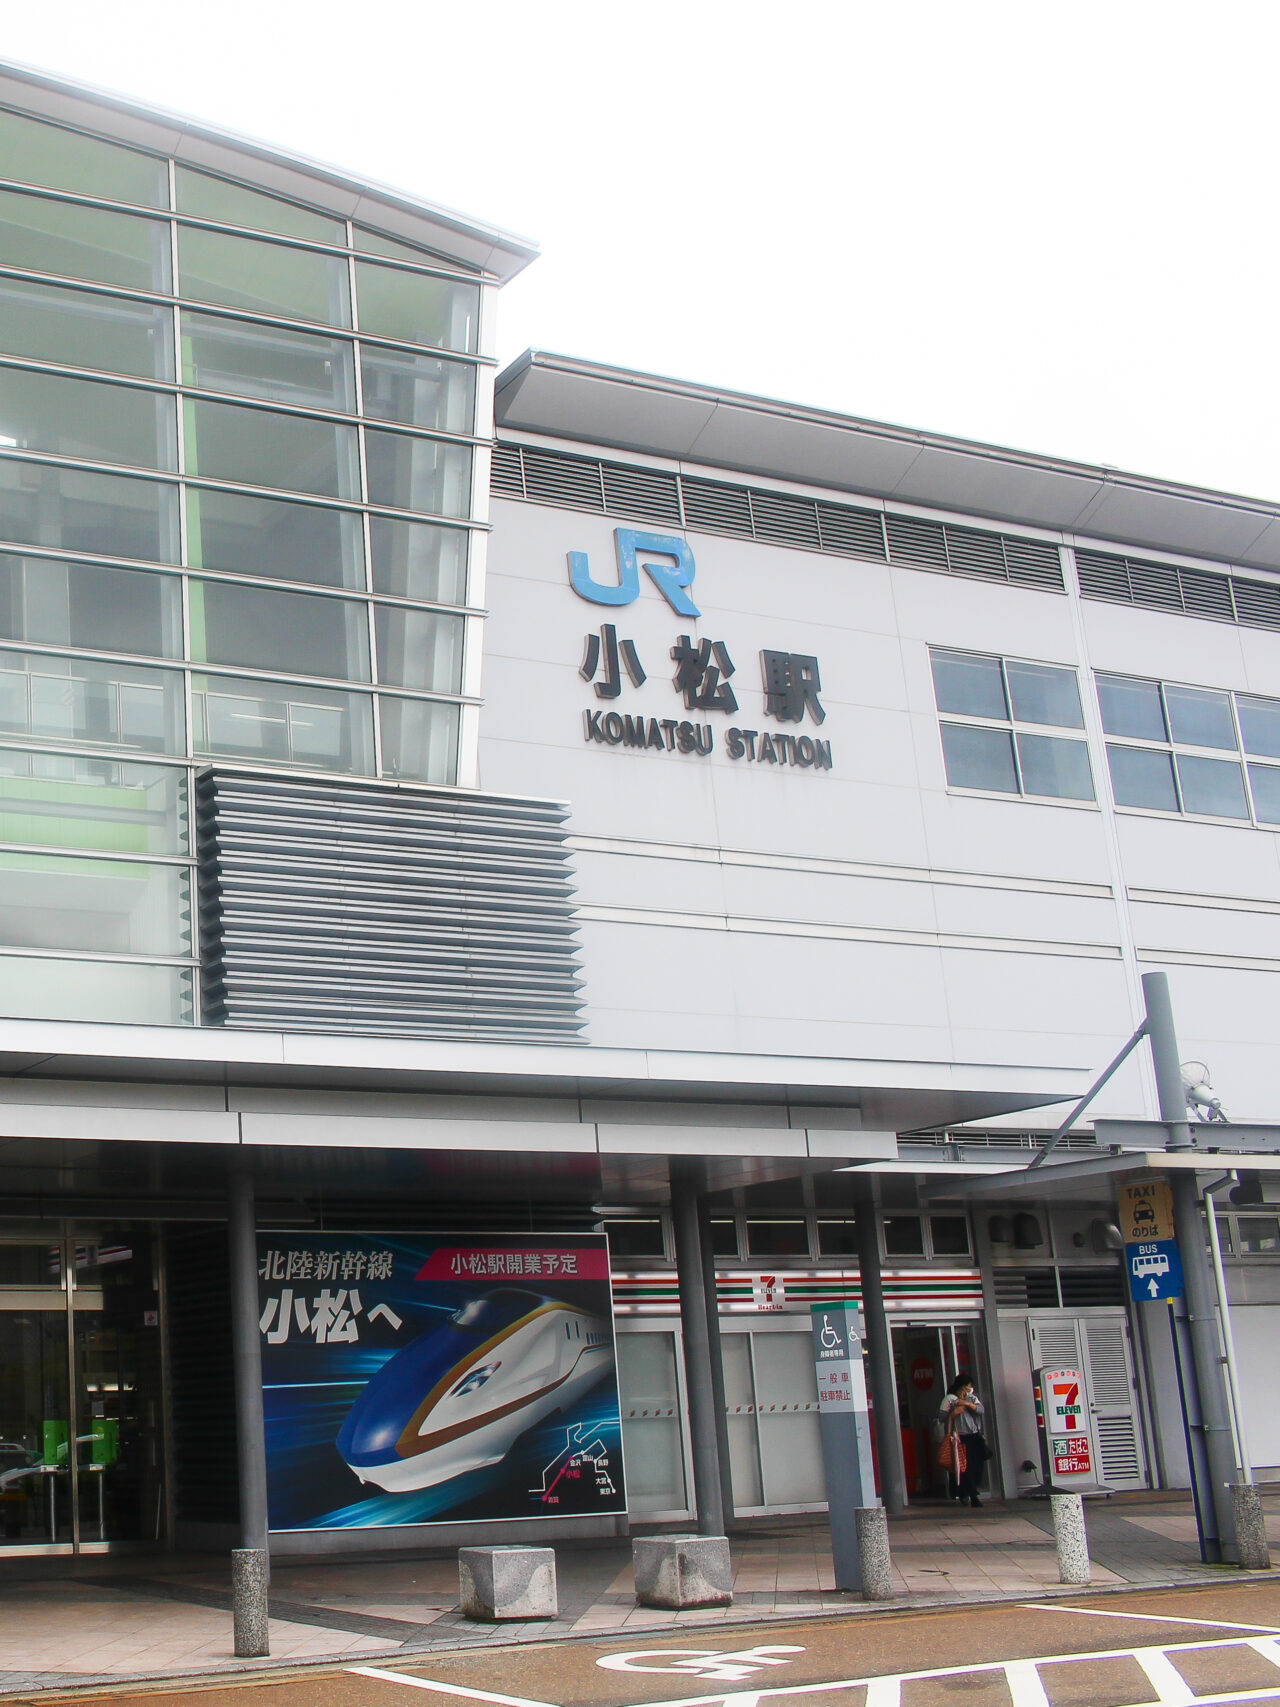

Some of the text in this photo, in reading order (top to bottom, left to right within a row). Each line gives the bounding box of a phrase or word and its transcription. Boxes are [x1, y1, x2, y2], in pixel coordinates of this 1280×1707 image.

[567, 527, 702, 618] JR
[579, 623, 826, 726] 小松駅
[583, 709, 833, 771] KOMATSU STATION
[1127, 1185, 1155, 1199] TAXI
[1132, 1224, 1159, 1237] のりば
[1139, 1244, 1158, 1255] BUS
[258, 1250, 393, 1281] 北陸新幹線
[451, 1253, 578, 1274] 小松駅開業予定
[259, 1289, 403, 1344] 小松へ
[914, 1368, 933, 1380] ATM
[1053, 1383, 1079, 1430] 7
[1055, 1439, 1089, 1455] 酒 たばこ
